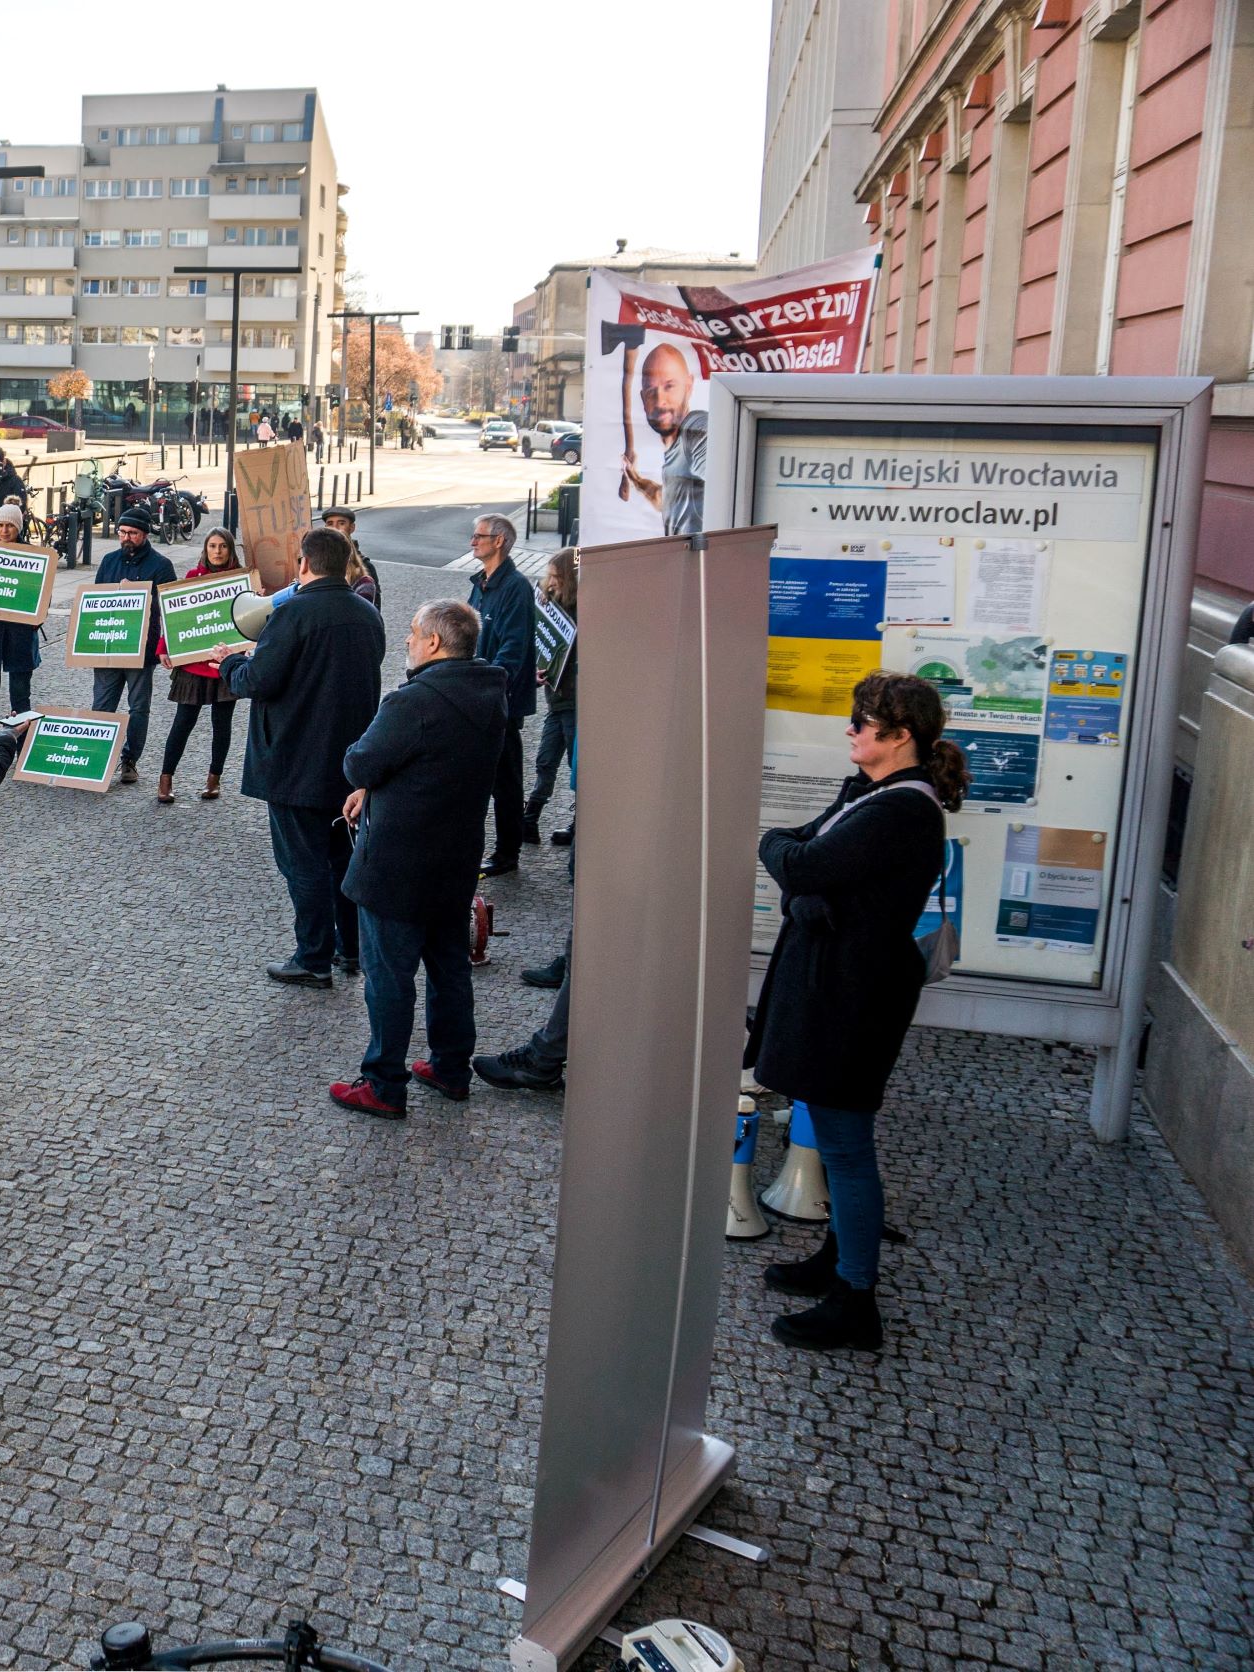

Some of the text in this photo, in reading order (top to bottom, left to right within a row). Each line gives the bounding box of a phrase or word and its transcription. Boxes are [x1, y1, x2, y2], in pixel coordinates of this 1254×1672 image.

[690, 313, 731, 338] nie
[731, 282, 863, 338] przerżnij
[703, 336, 845, 373] tego miasta!
[237, 452, 280, 500] W
[778, 455, 1119, 489] Urząd Miejski Wrocławia
[828, 501, 1059, 532] www.wroclaw.pl
[85, 598, 140, 609] NIE ODDAMY!
[168, 584, 243, 609] NIE ODDAMY!
[196, 609, 221, 624] park
[89, 629, 128, 643] olimpijski
[178, 621, 236, 643] południow
[43, 723, 110, 738] NIE ODDAMY!
[45, 753, 89, 766] złotnicki
